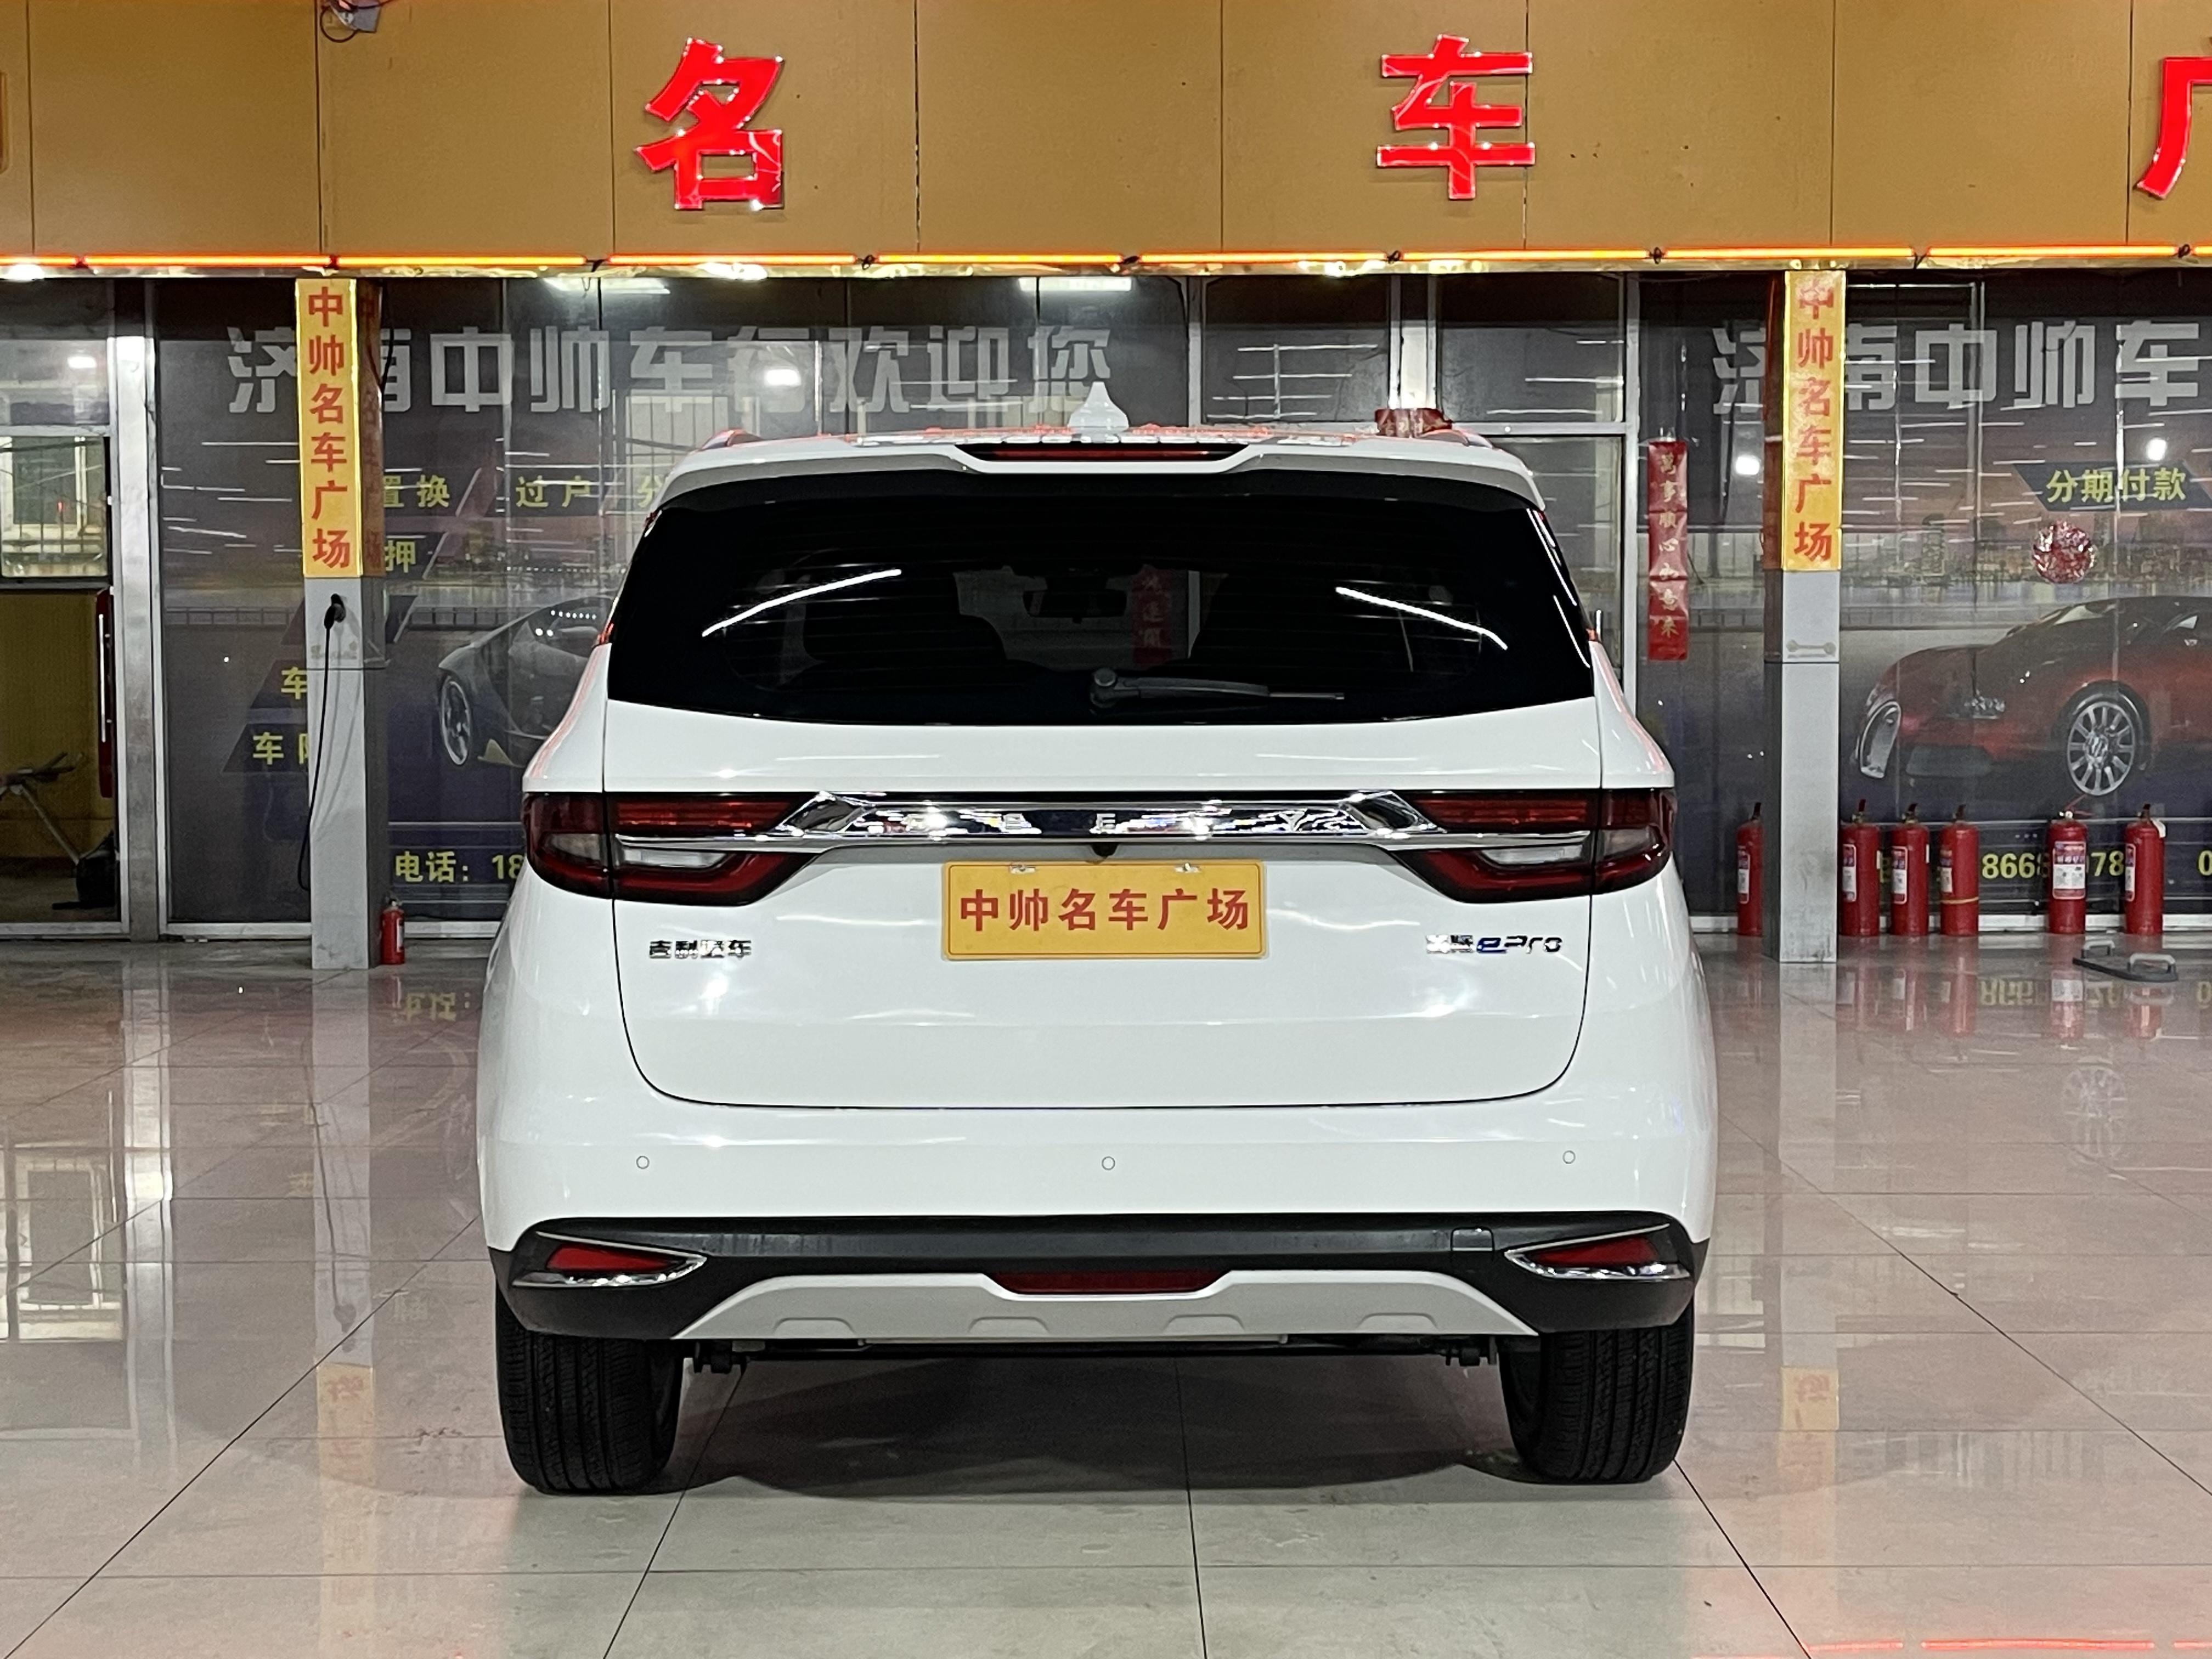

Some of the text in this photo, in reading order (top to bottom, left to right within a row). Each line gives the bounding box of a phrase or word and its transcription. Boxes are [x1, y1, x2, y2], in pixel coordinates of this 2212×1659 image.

[308, 286, 351, 568] 中帅名车广场
[1794, 277, 1834, 563] 中帅名车广场
[516, 475, 592, 508] 过户
[2046, 467, 2187, 503] 分期付款
[385, 540, 416, 573] 押
[961, 888, 1249, 932] 中帅名车广场
